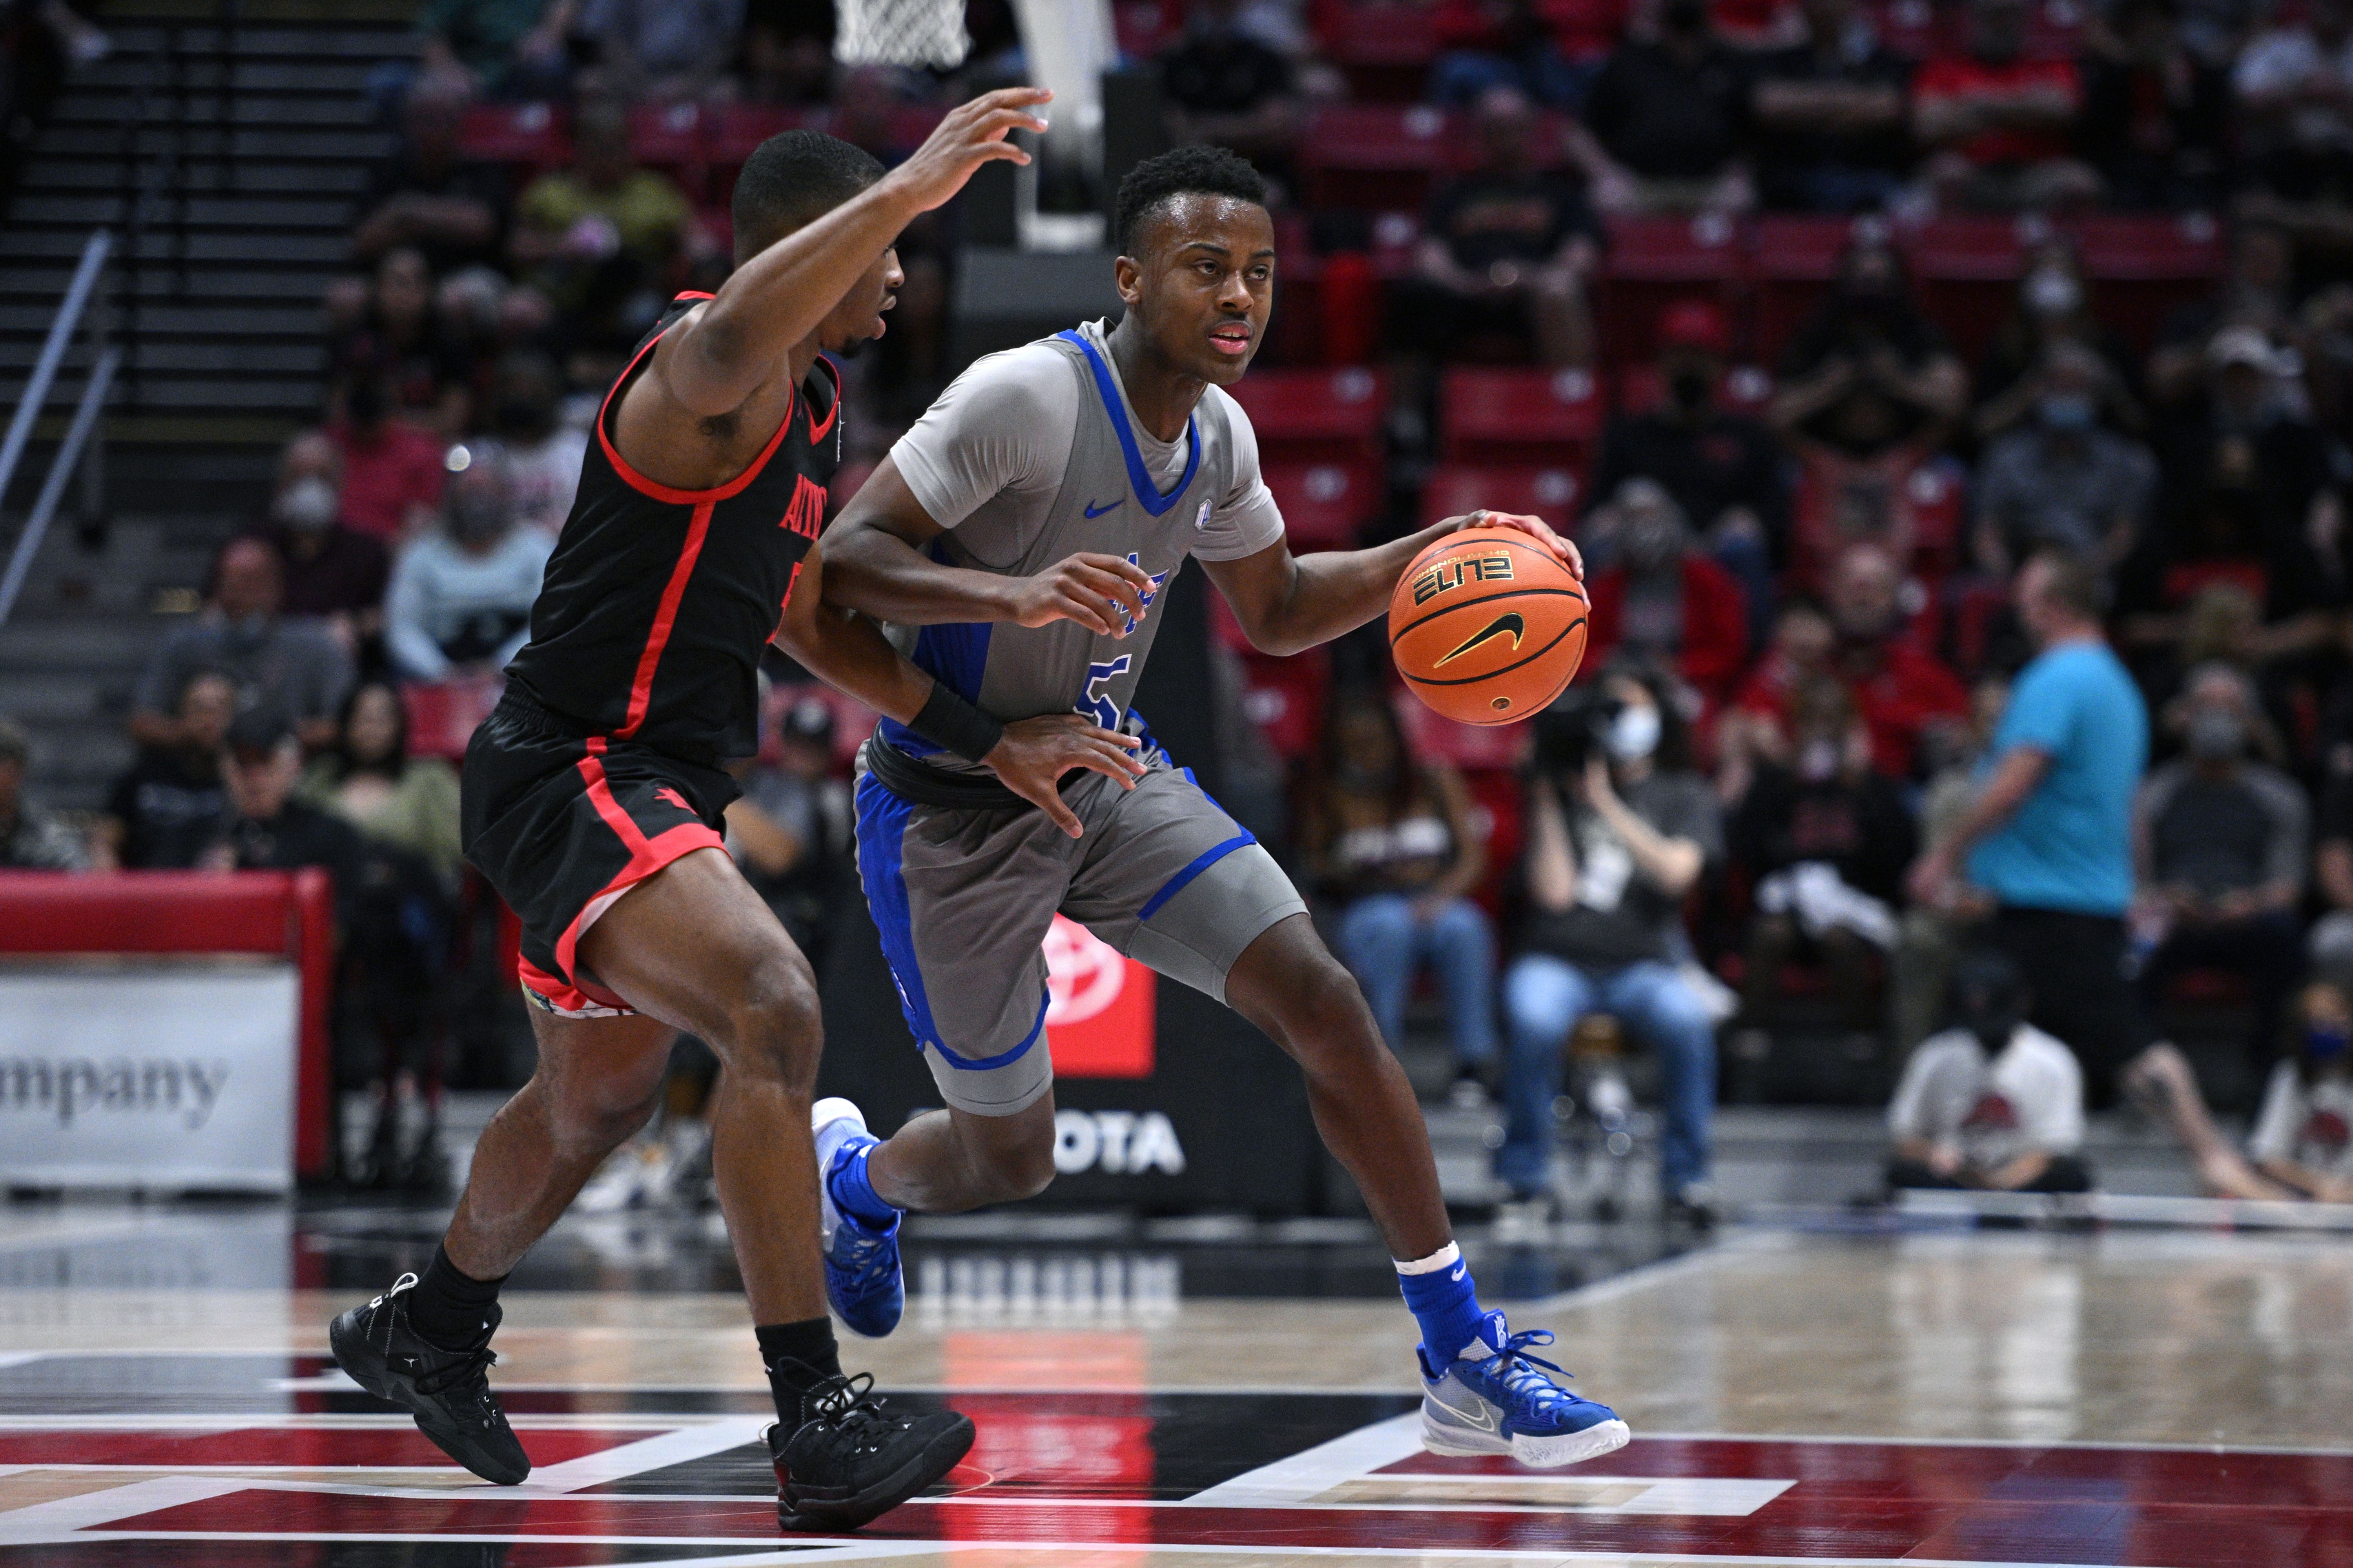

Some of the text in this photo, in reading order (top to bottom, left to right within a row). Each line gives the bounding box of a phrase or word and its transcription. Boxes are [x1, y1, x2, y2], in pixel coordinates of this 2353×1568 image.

[1412, 555, 1514, 607] ELITE
[1073, 654, 1132, 732] 5
[0, 1055, 229, 1130] mpany
